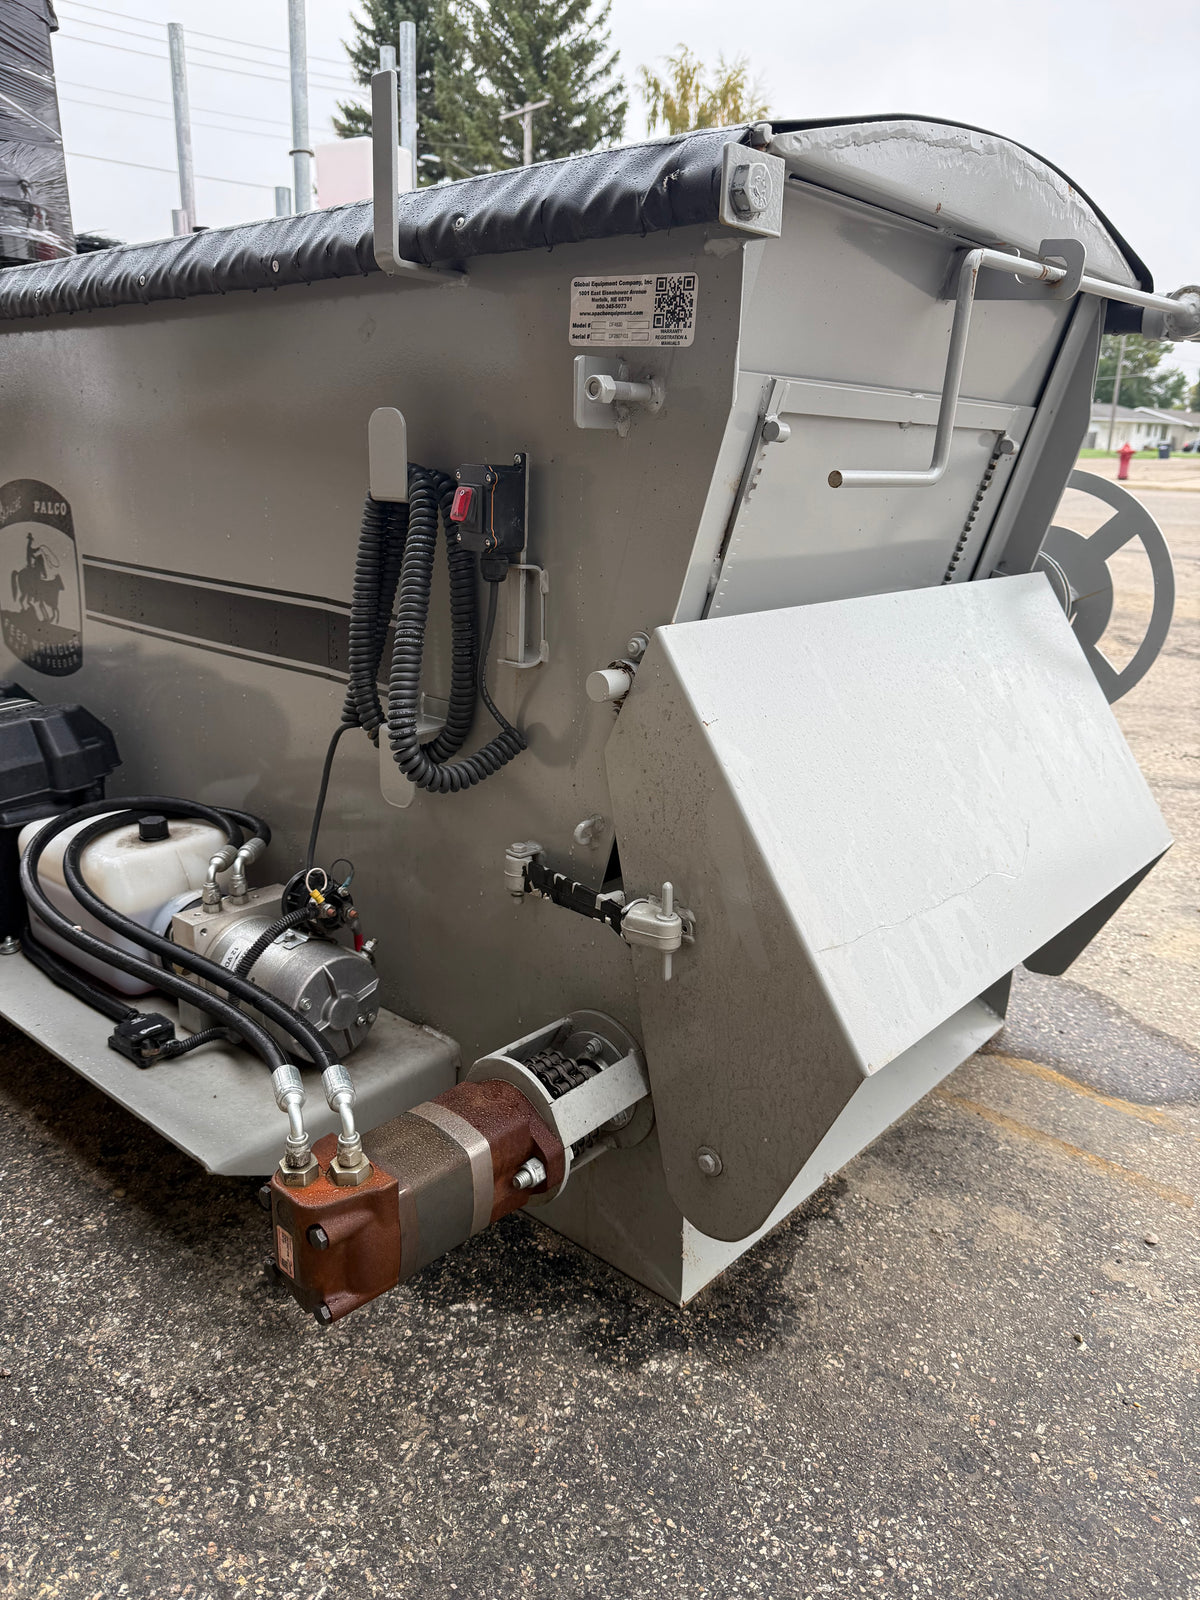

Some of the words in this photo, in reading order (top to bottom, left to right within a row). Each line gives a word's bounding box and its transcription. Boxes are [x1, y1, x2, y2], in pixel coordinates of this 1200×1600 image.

[33, 501, 67, 516] PALCO
[4, 618, 28, 645] FEED
[32, 637, 80, 656] WRANGLER
